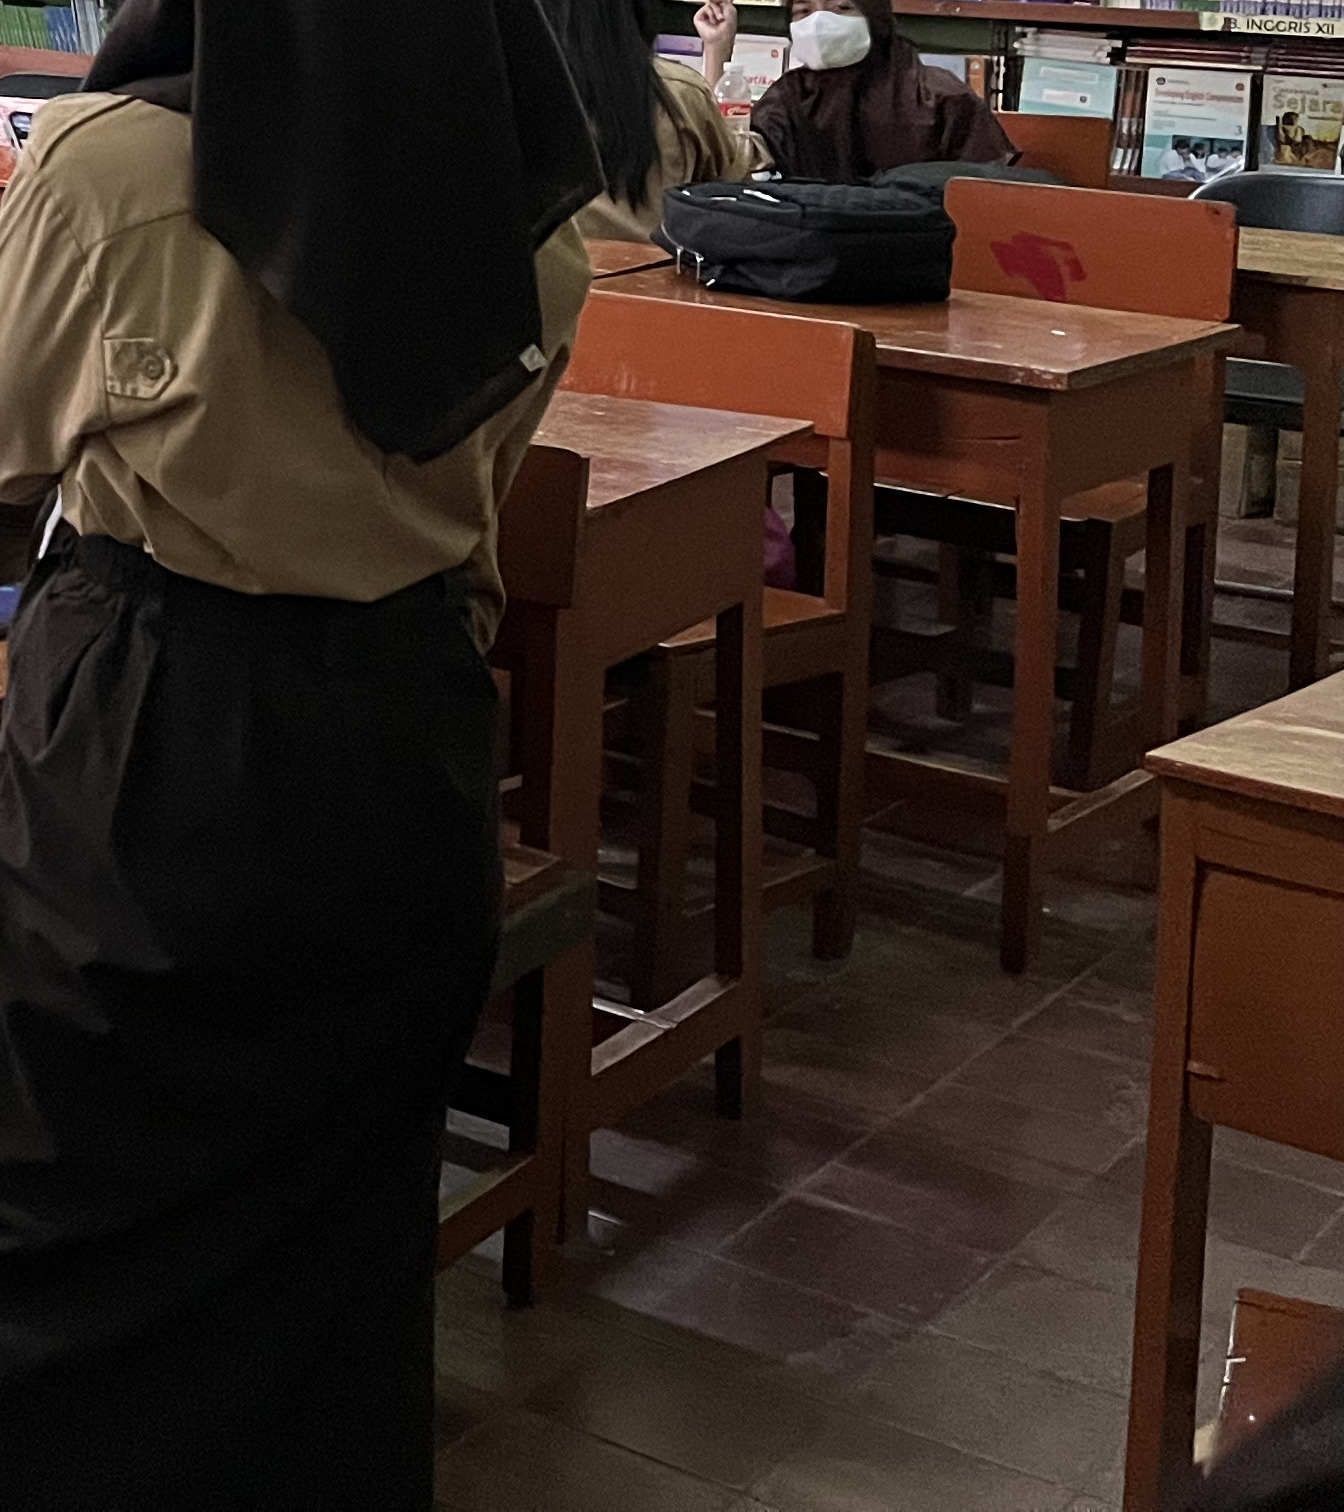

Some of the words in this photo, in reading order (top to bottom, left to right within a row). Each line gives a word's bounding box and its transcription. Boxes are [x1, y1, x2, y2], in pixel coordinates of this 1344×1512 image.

[1246, 18, 1311, 34] INGGRIS
[1315, 23, 1335, 35] XII
[1234, 124, 1243, 137] 3
